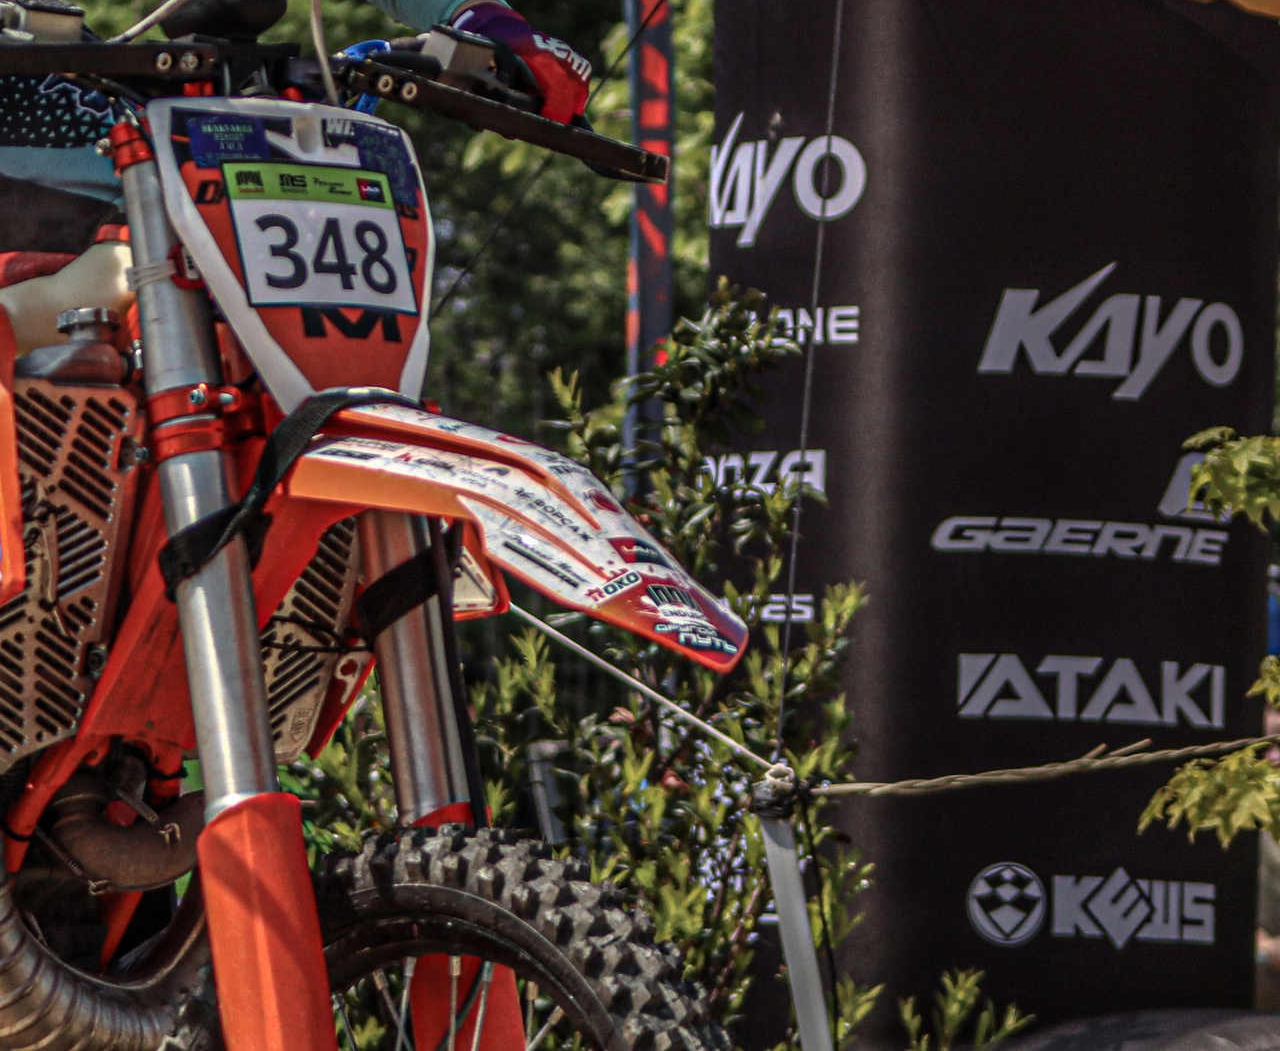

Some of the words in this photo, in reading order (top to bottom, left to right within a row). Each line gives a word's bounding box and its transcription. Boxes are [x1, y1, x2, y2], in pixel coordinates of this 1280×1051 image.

[255, 213, 398, 295] 348
[977, 260, 1244, 400] KAYO
[931, 516, 1229, 565] GAERNE
[678, 632, 738, 655] ПУТЬ
[958, 653, 1226, 729] ATAKI
